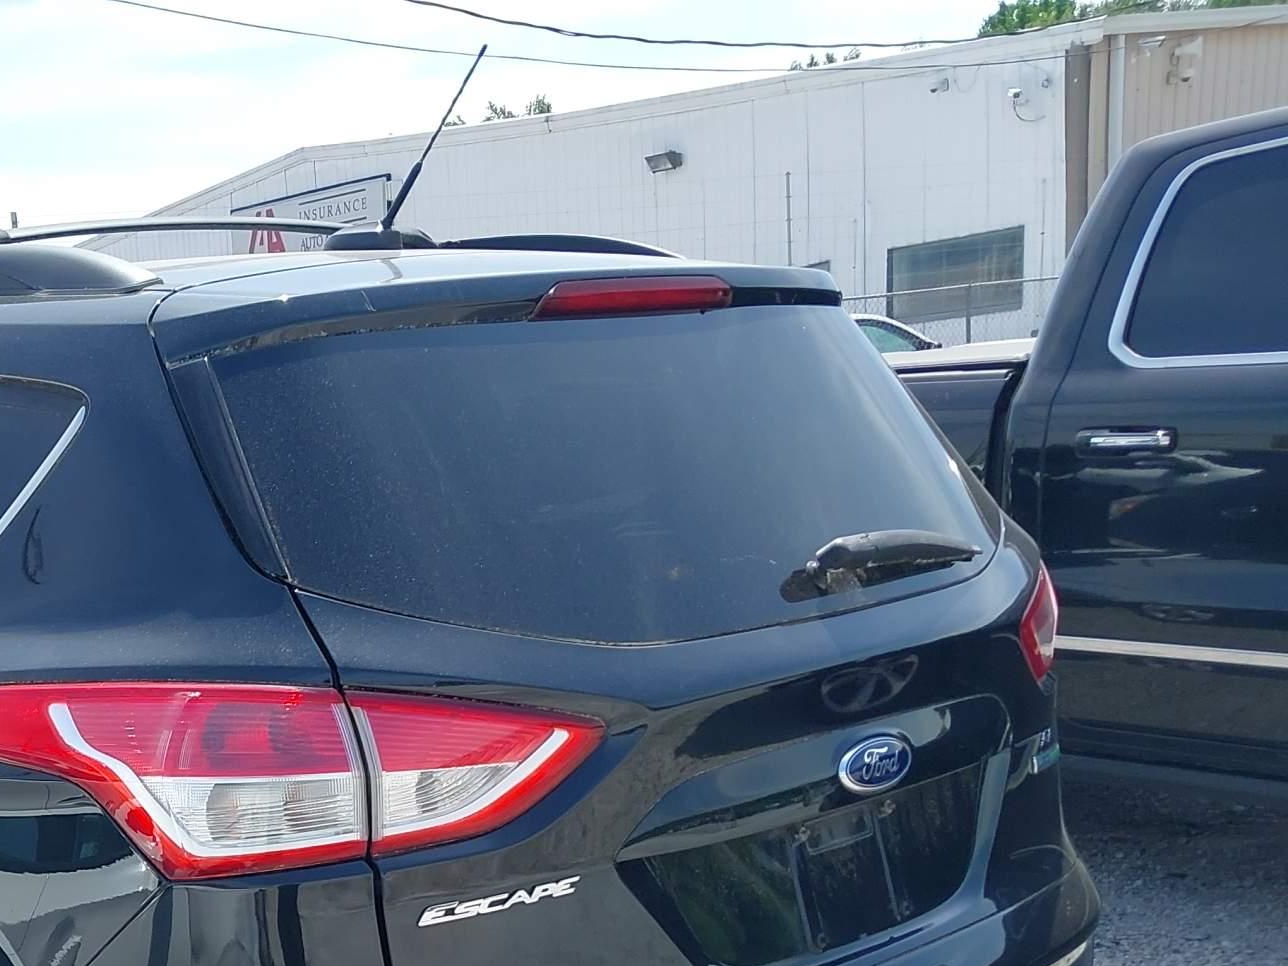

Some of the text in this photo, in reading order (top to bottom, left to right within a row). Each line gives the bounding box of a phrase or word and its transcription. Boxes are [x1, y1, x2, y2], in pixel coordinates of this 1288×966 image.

[298, 197, 368, 220] INSURANCE
[300, 235, 323, 252] AUTO
[862, 746, 900, 781] Ford
[417, 875, 581, 927] ESCAPE
